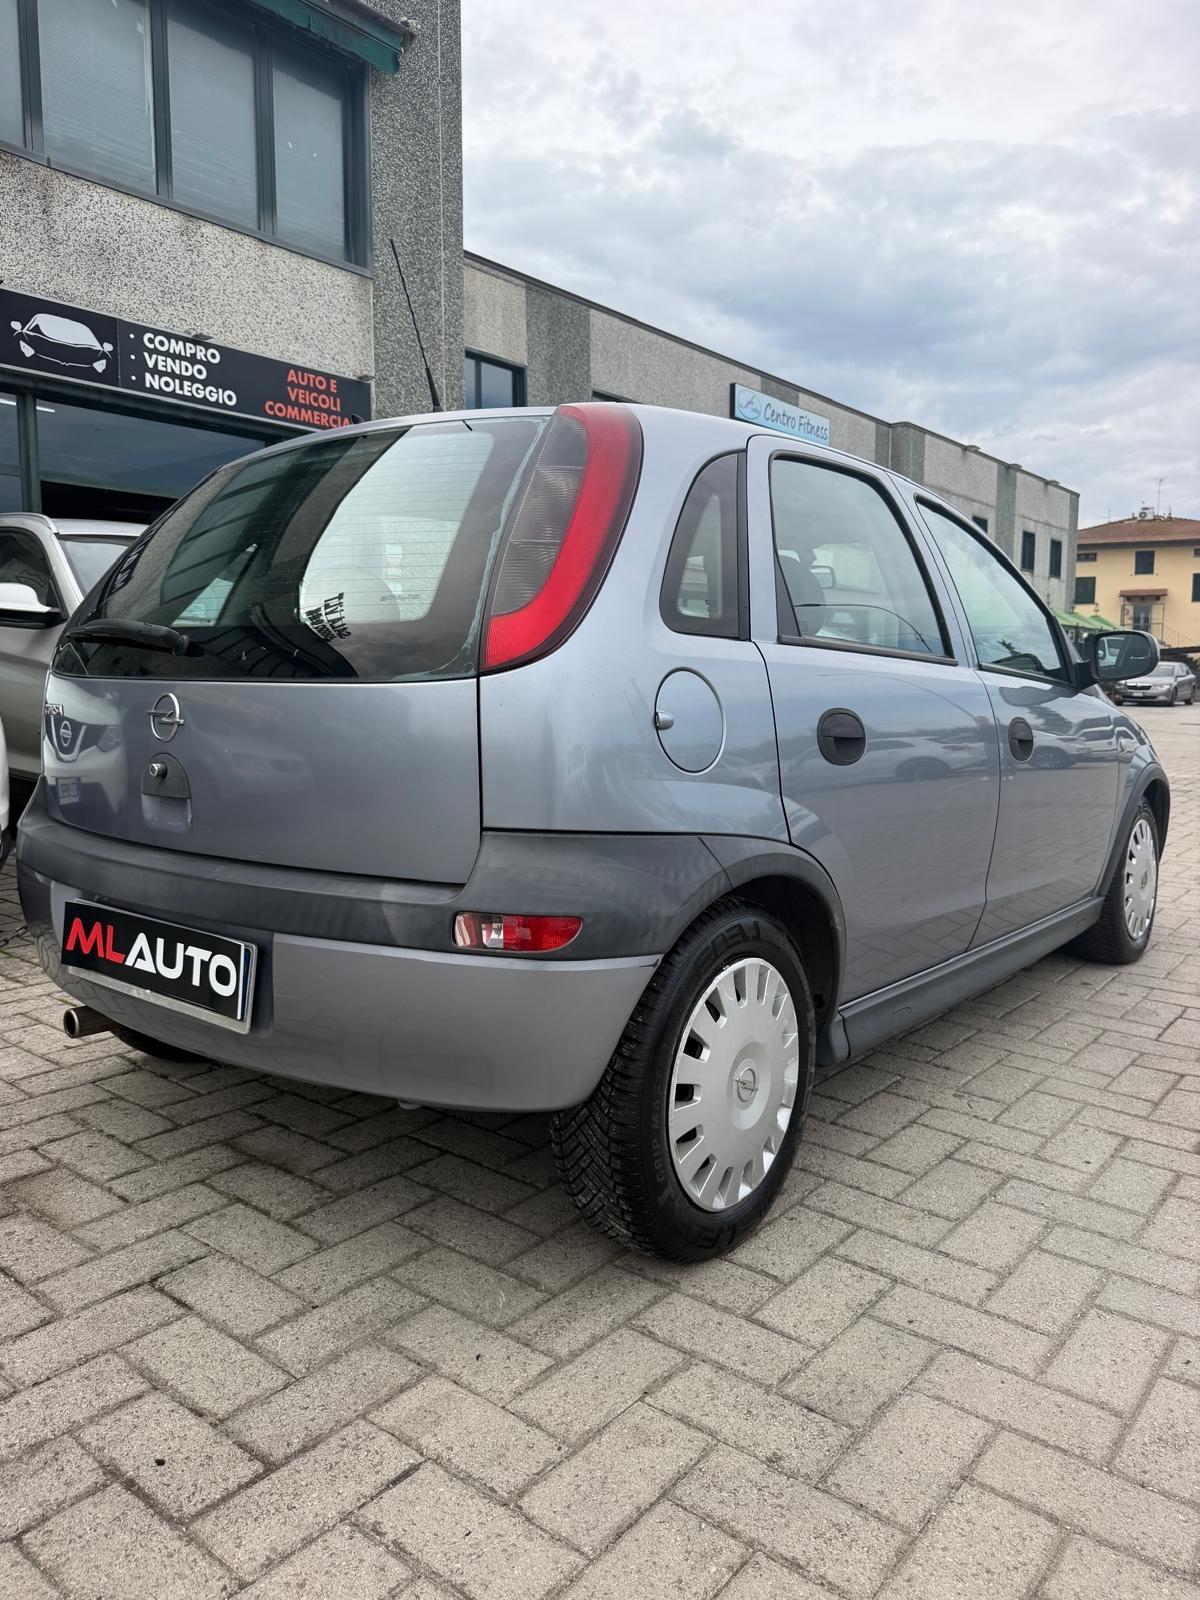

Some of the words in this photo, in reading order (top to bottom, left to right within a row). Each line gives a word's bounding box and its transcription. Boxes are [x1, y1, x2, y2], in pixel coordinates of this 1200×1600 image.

[143, 332, 221, 364] COMPRO
[143, 351, 208, 380] VENDO
[144, 372, 237, 407] NOLEGGIO
[287, 368, 327, 390] AUTO
[330, 379, 337, 393] E
[287, 386, 341, 412] VEICOLI
[264, 400, 350, 429] COMMERCIA
[763, 402, 797, 430] Centro
[798, 414, 828, 441] Fitness
